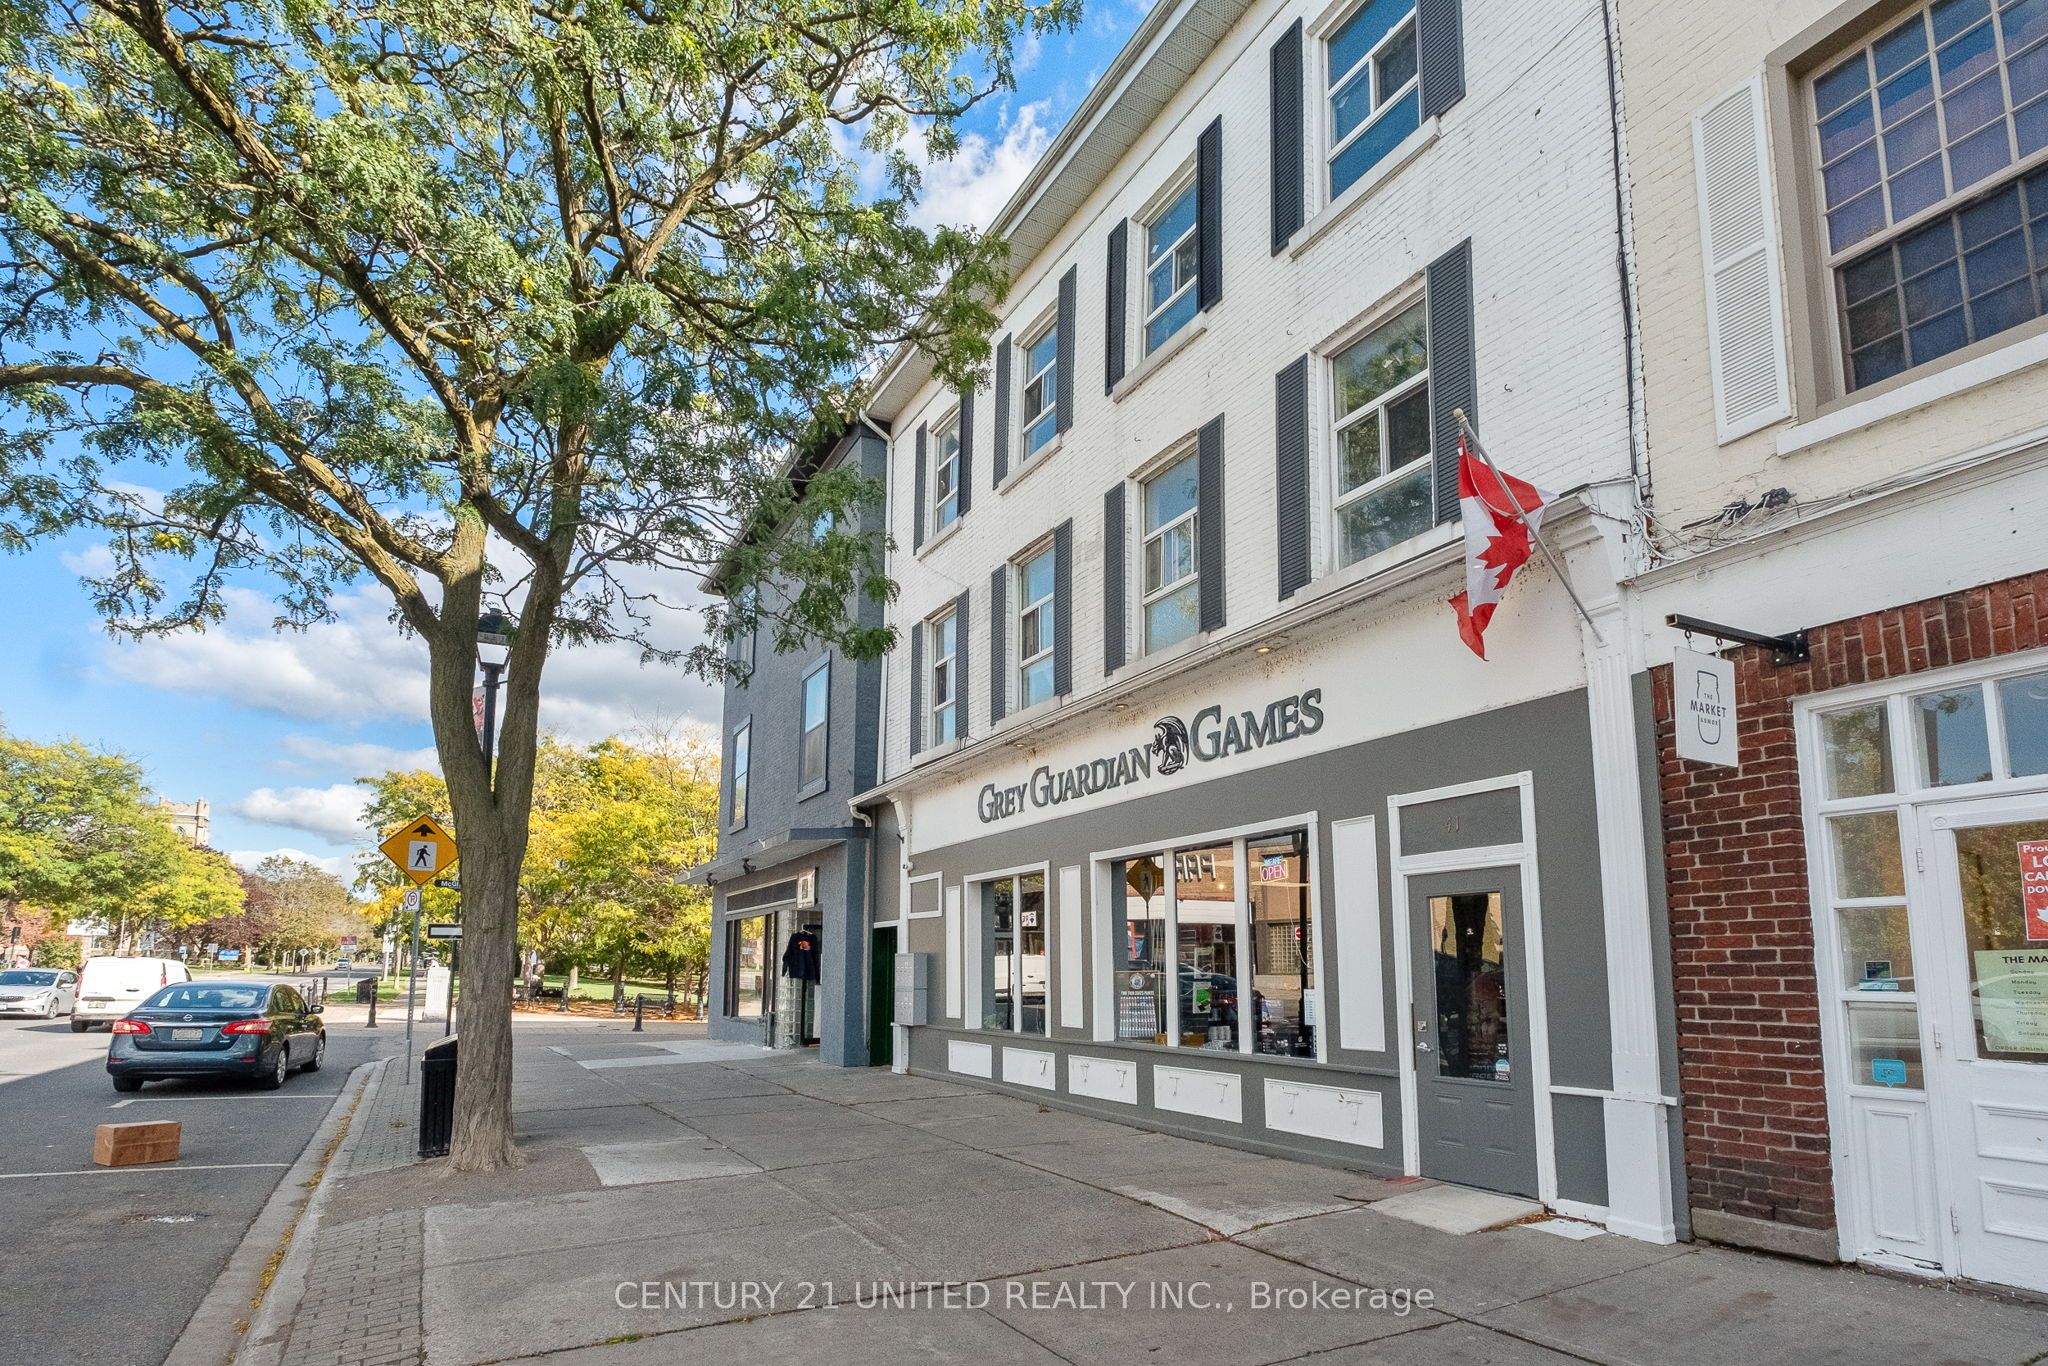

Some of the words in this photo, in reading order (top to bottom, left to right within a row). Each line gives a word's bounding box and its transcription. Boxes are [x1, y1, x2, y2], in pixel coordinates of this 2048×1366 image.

[1690, 699, 1727, 718] MARKET
[977, 782, 1028, 824] GREY
[1030, 744, 1152, 808] GUARDIAN
[1189, 687, 1324, 763] GAMES
[1261, 863, 1286, 881] OPEN
[2002, 955, 2024, 964] THE
